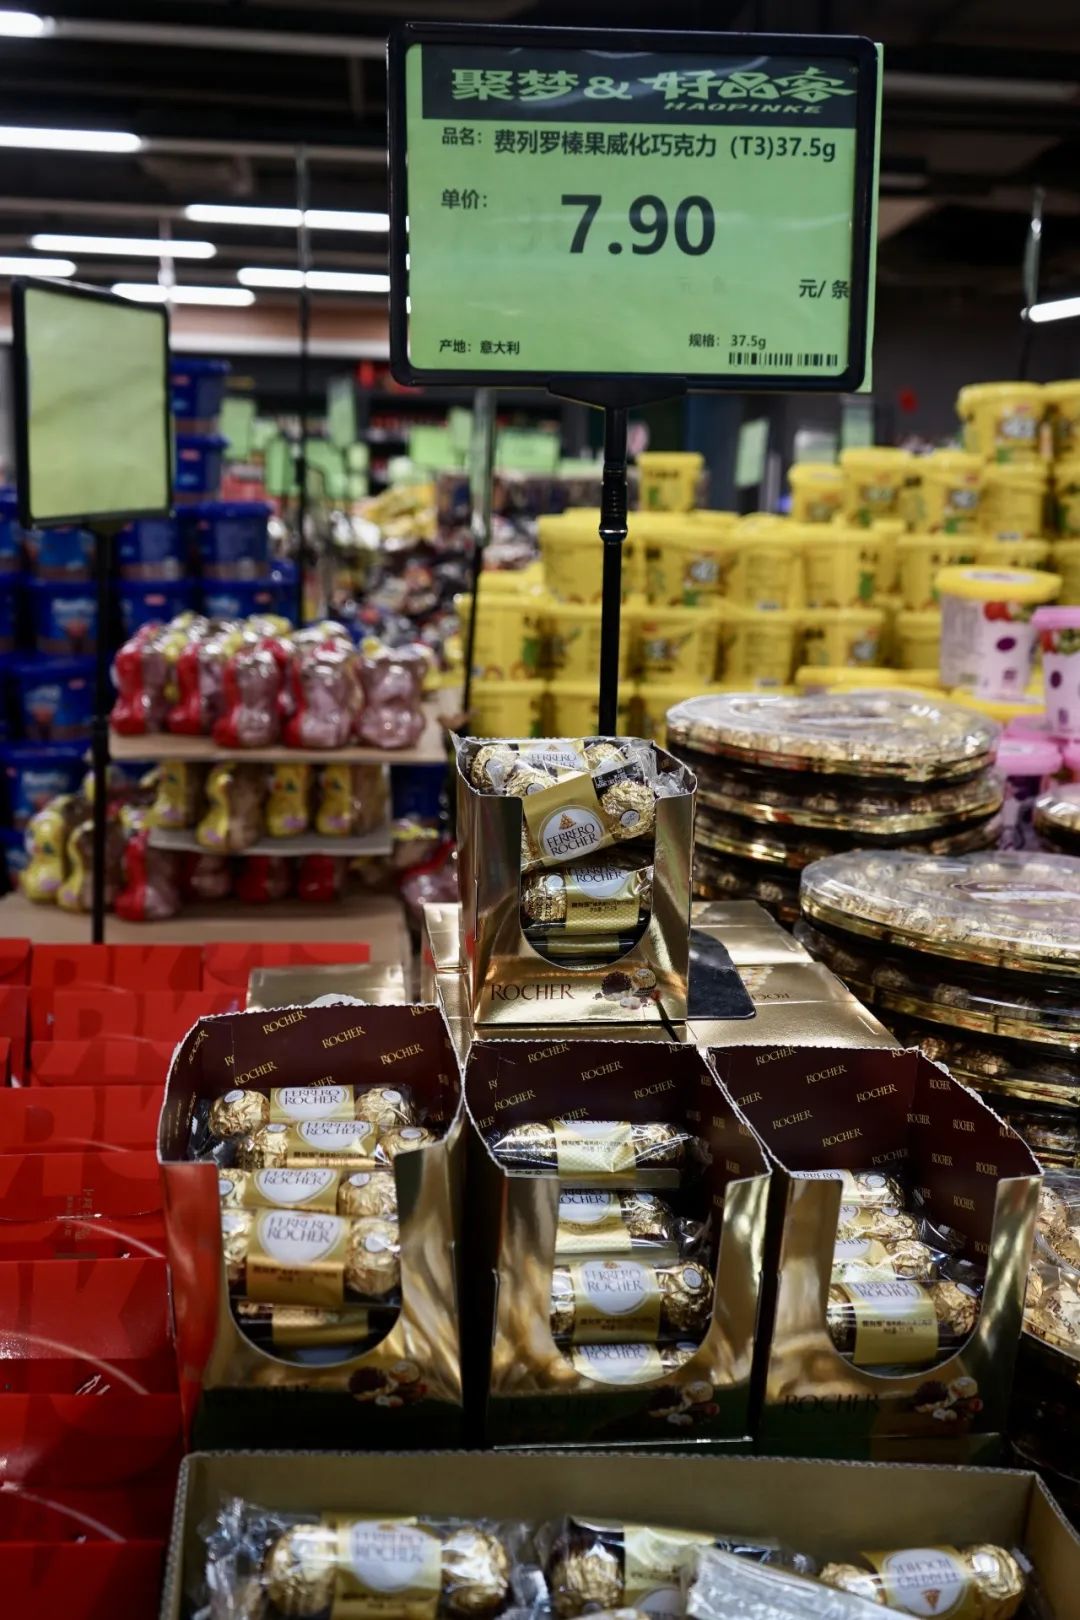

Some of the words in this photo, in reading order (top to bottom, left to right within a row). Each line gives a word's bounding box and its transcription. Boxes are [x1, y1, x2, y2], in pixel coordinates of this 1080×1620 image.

[664, 102, 823, 114] HAOPINKE
[494, 129, 716, 157] 费列罗榛果威化巧克力
[561, 194, 715, 256] 7.90
[546, 823, 595, 848] FERRERO
[551, 834, 599, 856] ROCHER
[576, 871, 625, 882] ROCHER
[491, 984, 575, 1001] ROCHER
[262, 1010, 307, 1034] ROCHER
[322, 1026, 366, 1048] ROCHER
[380, 1043, 424, 1065] ROCHER
[528, 1043, 570, 1063] ROCHER
[756, 1047, 797, 1065] ROCHER
[234, 1061, 278, 1086] ROCHER
[581, 1061, 623, 1081] ROCHER
[806, 1064, 848, 1084] ROCHER
[285, 1089, 340, 1097] FERRERO
[634, 1080, 676, 1099] ROCHER
[856, 1084, 898, 1102] ROCHER
[285, 1096, 339, 1105] ROCHER
[494, 1089, 536, 1111] ROCHER
[772, 1110, 813, 1129] ROCHER
[306, 1128, 361, 1136] ROCHER
[822, 1128, 863, 1147] ROCHER
[264, 1177, 323, 1185] ROCHER
[269, 1217, 334, 1230] FERRERO
[267, 1228, 330, 1243] ROCHER
[585, 1269, 641, 1282] FERRERO
[587, 1280, 644, 1292] ROCHER
